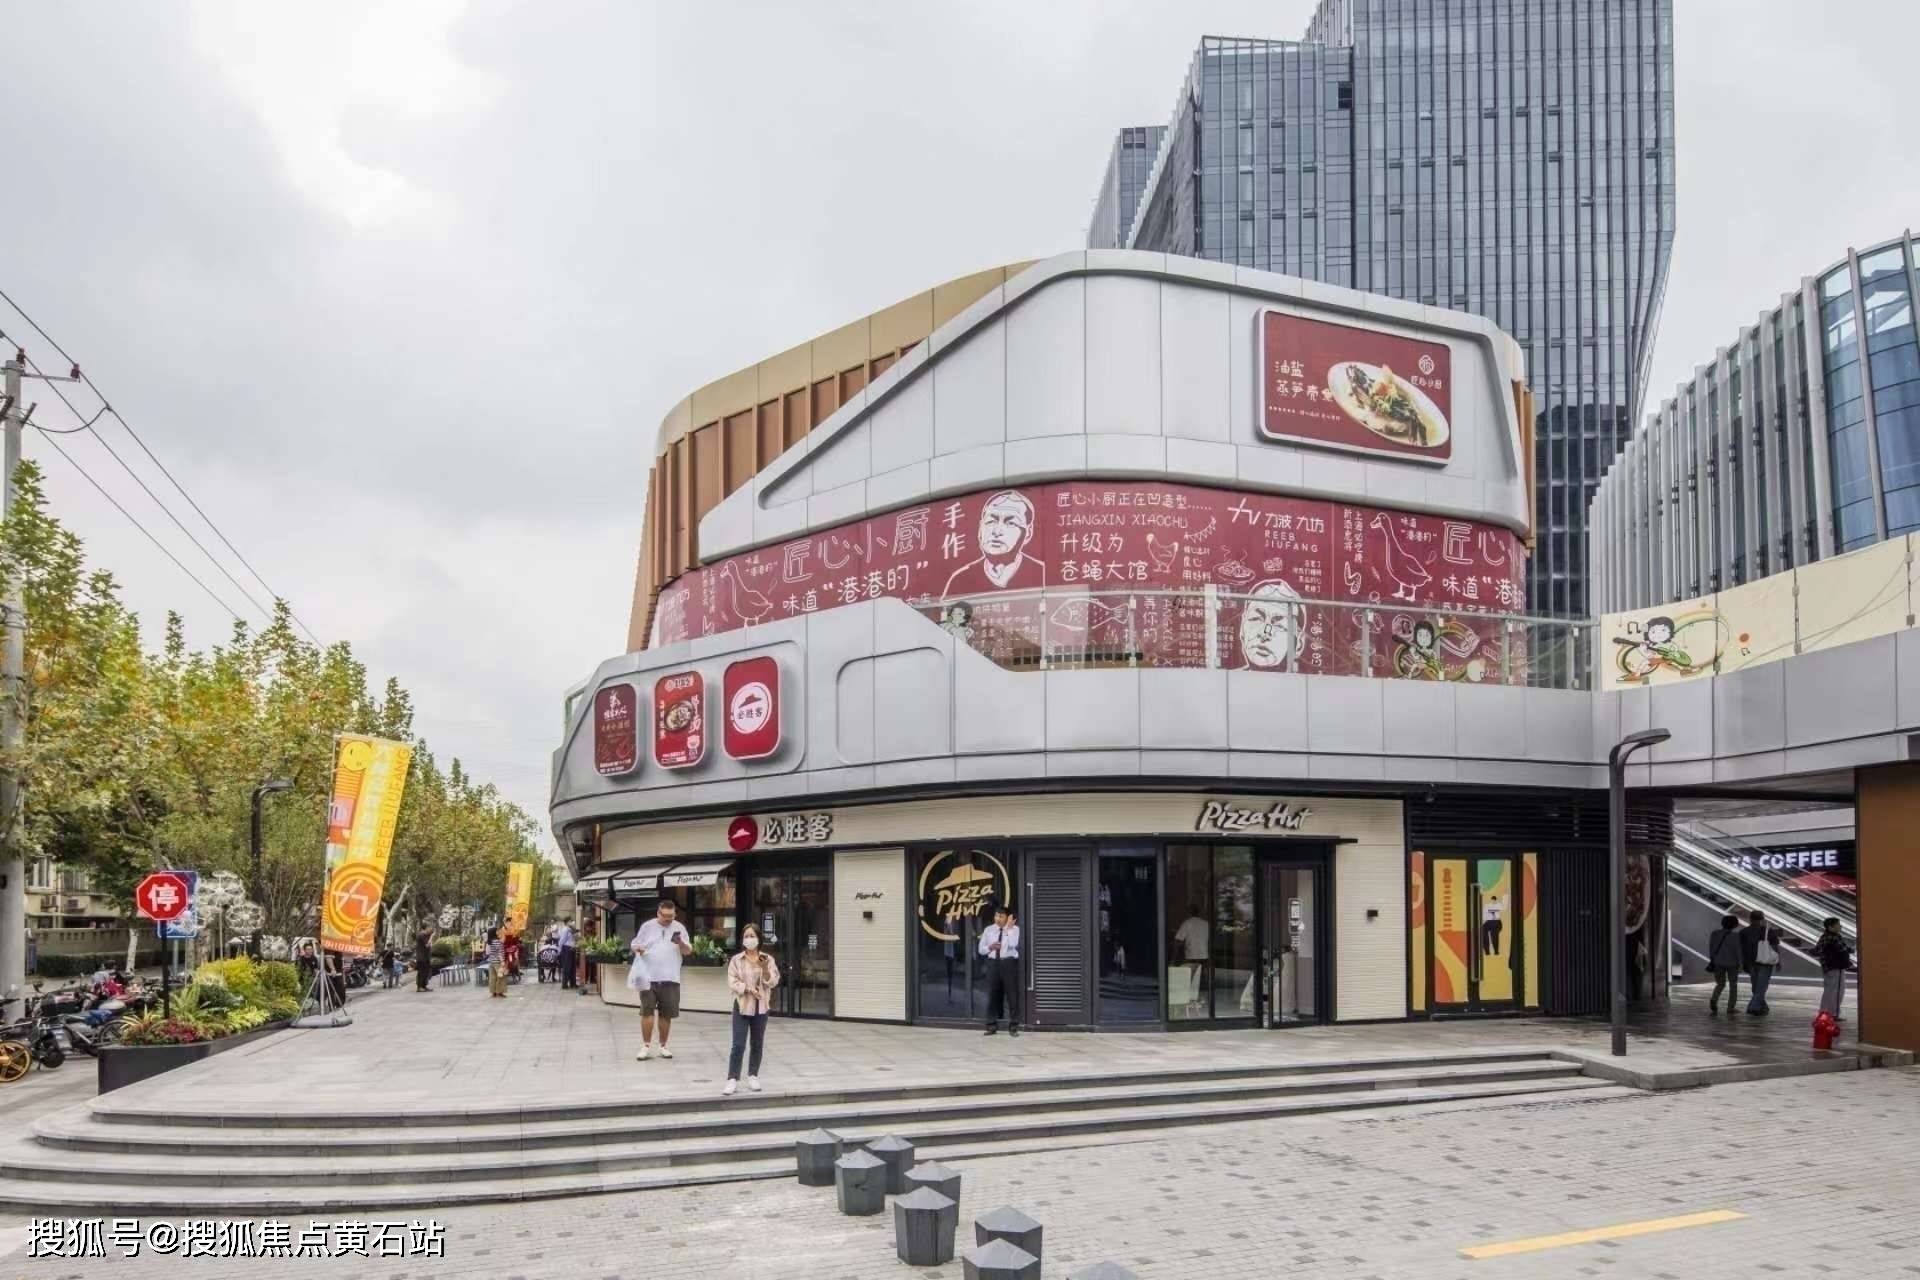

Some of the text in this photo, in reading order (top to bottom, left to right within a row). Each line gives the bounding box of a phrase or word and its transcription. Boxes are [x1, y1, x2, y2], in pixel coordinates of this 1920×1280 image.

[1057, 514, 1188, 529] JIANGXIN XIAOCHU
[783, 507, 930, 583] 匠心小厨
[1060, 532, 1123, 553] 升级为
[1264, 530, 1295, 542] REEB
[1264, 540, 1319, 553] JIUFANG
[1060, 560, 1149, 582] 苍蝇大馆
[1197, 799, 1313, 831] Pizza Hut
[761, 813, 833, 845] 必胜客
[1759, 849, 1838, 870] COFFEE
[147, 883, 179, 912] 停
[936, 884, 994, 916] Pizza
[946, 900, 989, 924] Hut
